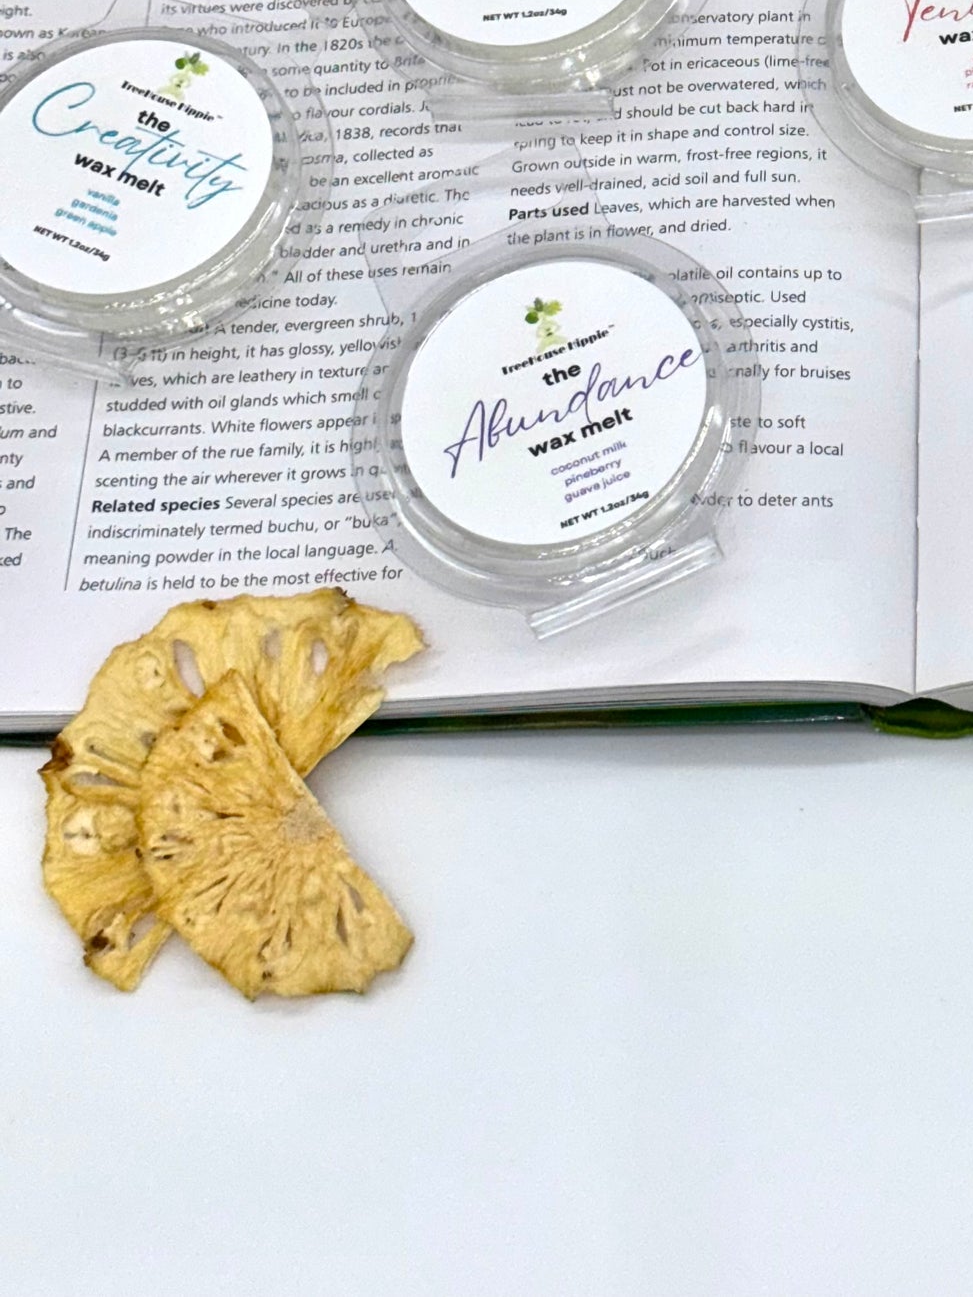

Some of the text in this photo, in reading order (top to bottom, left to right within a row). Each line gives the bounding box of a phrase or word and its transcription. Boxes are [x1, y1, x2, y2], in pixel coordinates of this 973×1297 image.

[482, 13, 501, 22] NET
[503, 11, 519, 20] WT
[954, 104, 972, 112] NET
[137, 109, 171, 133] the
[335, 124, 430, 142] 1838, records
[32, 82, 248, 210] Creativity
[74, 153, 166, 197] wax melt
[87, 188, 121, 207] vanilla
[71, 196, 118, 222] gardenia
[509, 201, 643, 221] Parts used Leaves,
[54, 206, 117, 237] green apple
[33, 224, 51, 238] NET
[49, 230, 70, 245] WT
[284, 266, 398, 284] All of these uses
[729, 315, 855, 332] especially cystitis,
[542, 364, 581, 387] the
[444, 348, 702, 479] Abundance
[103, 417, 313, 438] blackcurrants. White flowers
[527, 407, 634, 458] wax melt
[550, 440, 627, 476] coconut milk
[564, 458, 623, 488] pineberry
[563, 469, 631, 503] guava juice
[91, 498, 220, 514] Related species
[559, 516, 581, 530] NET
[581, 508, 599, 522] WT
[84, 550, 213, 567] meaning powder
